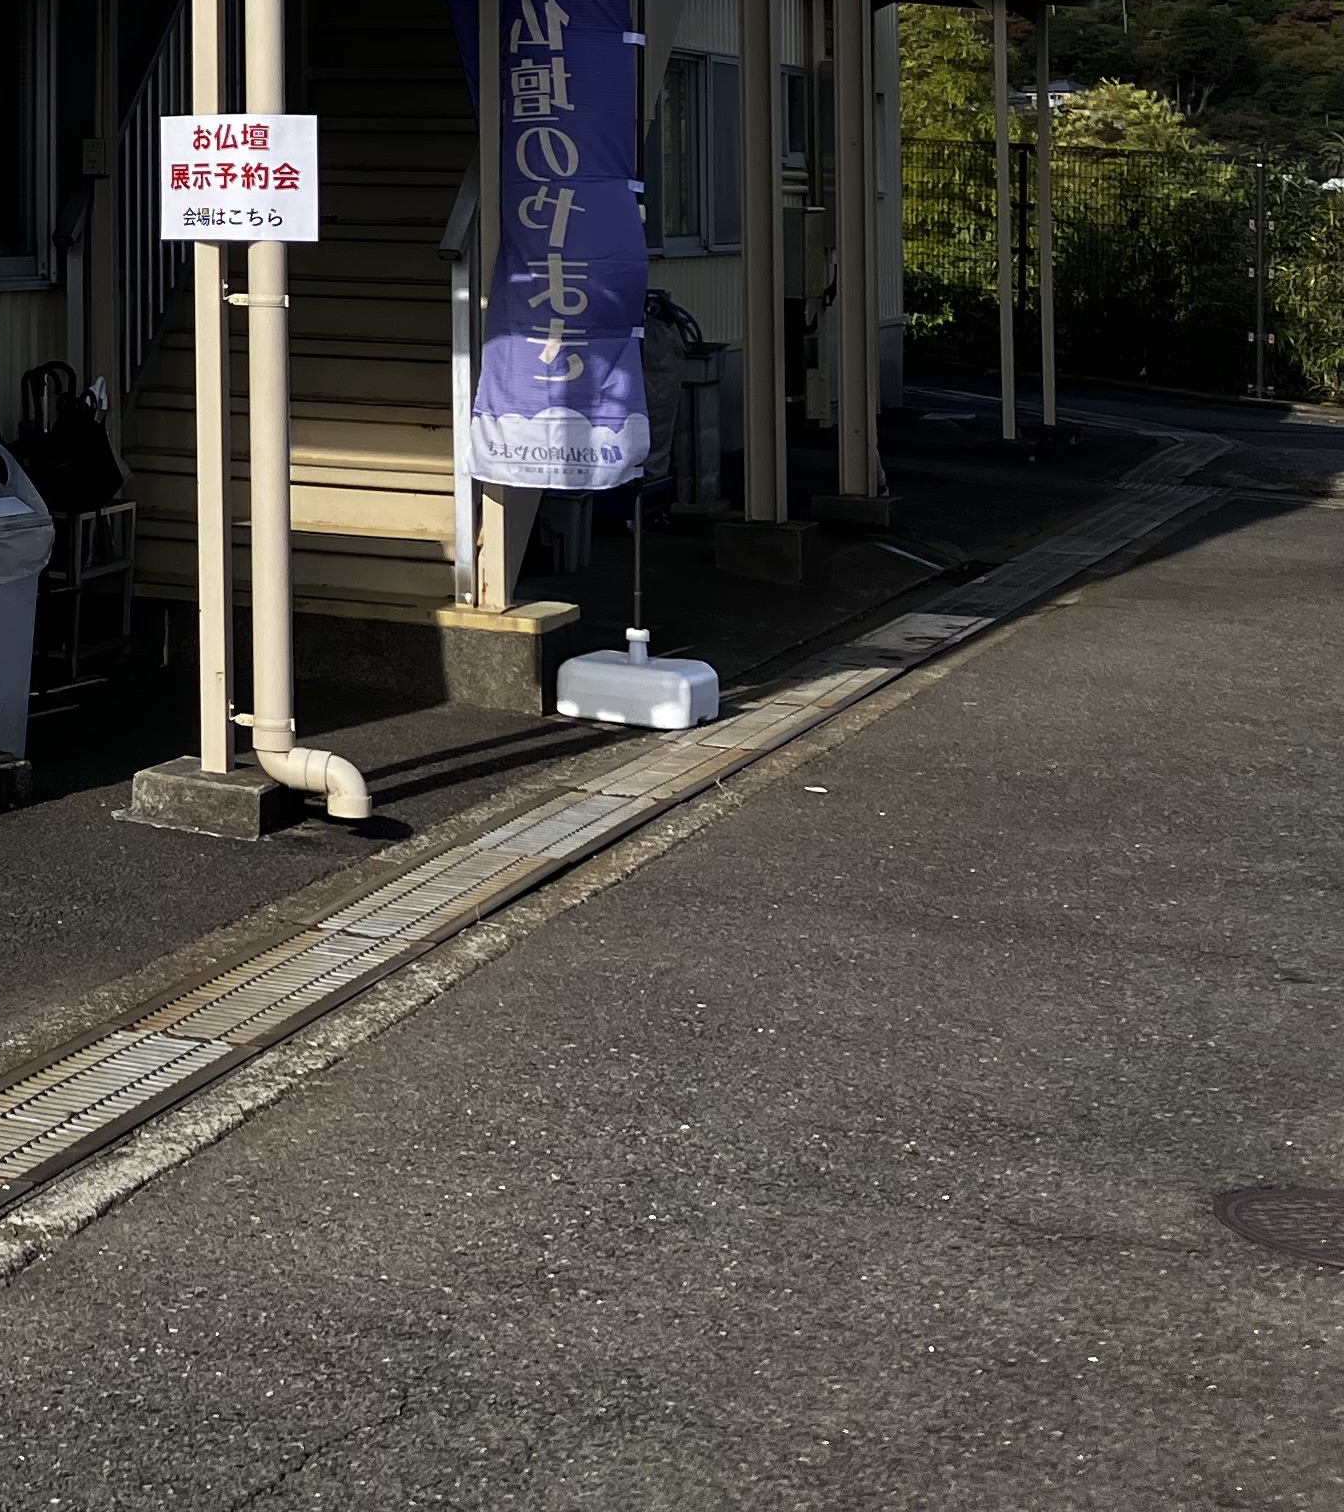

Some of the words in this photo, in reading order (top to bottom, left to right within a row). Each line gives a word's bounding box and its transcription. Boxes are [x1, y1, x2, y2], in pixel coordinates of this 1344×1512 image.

[192, 123, 270, 151] お仏壇
[170, 162, 301, 191] 展示予約会
[182, 206, 283, 227] 会場はこちら
